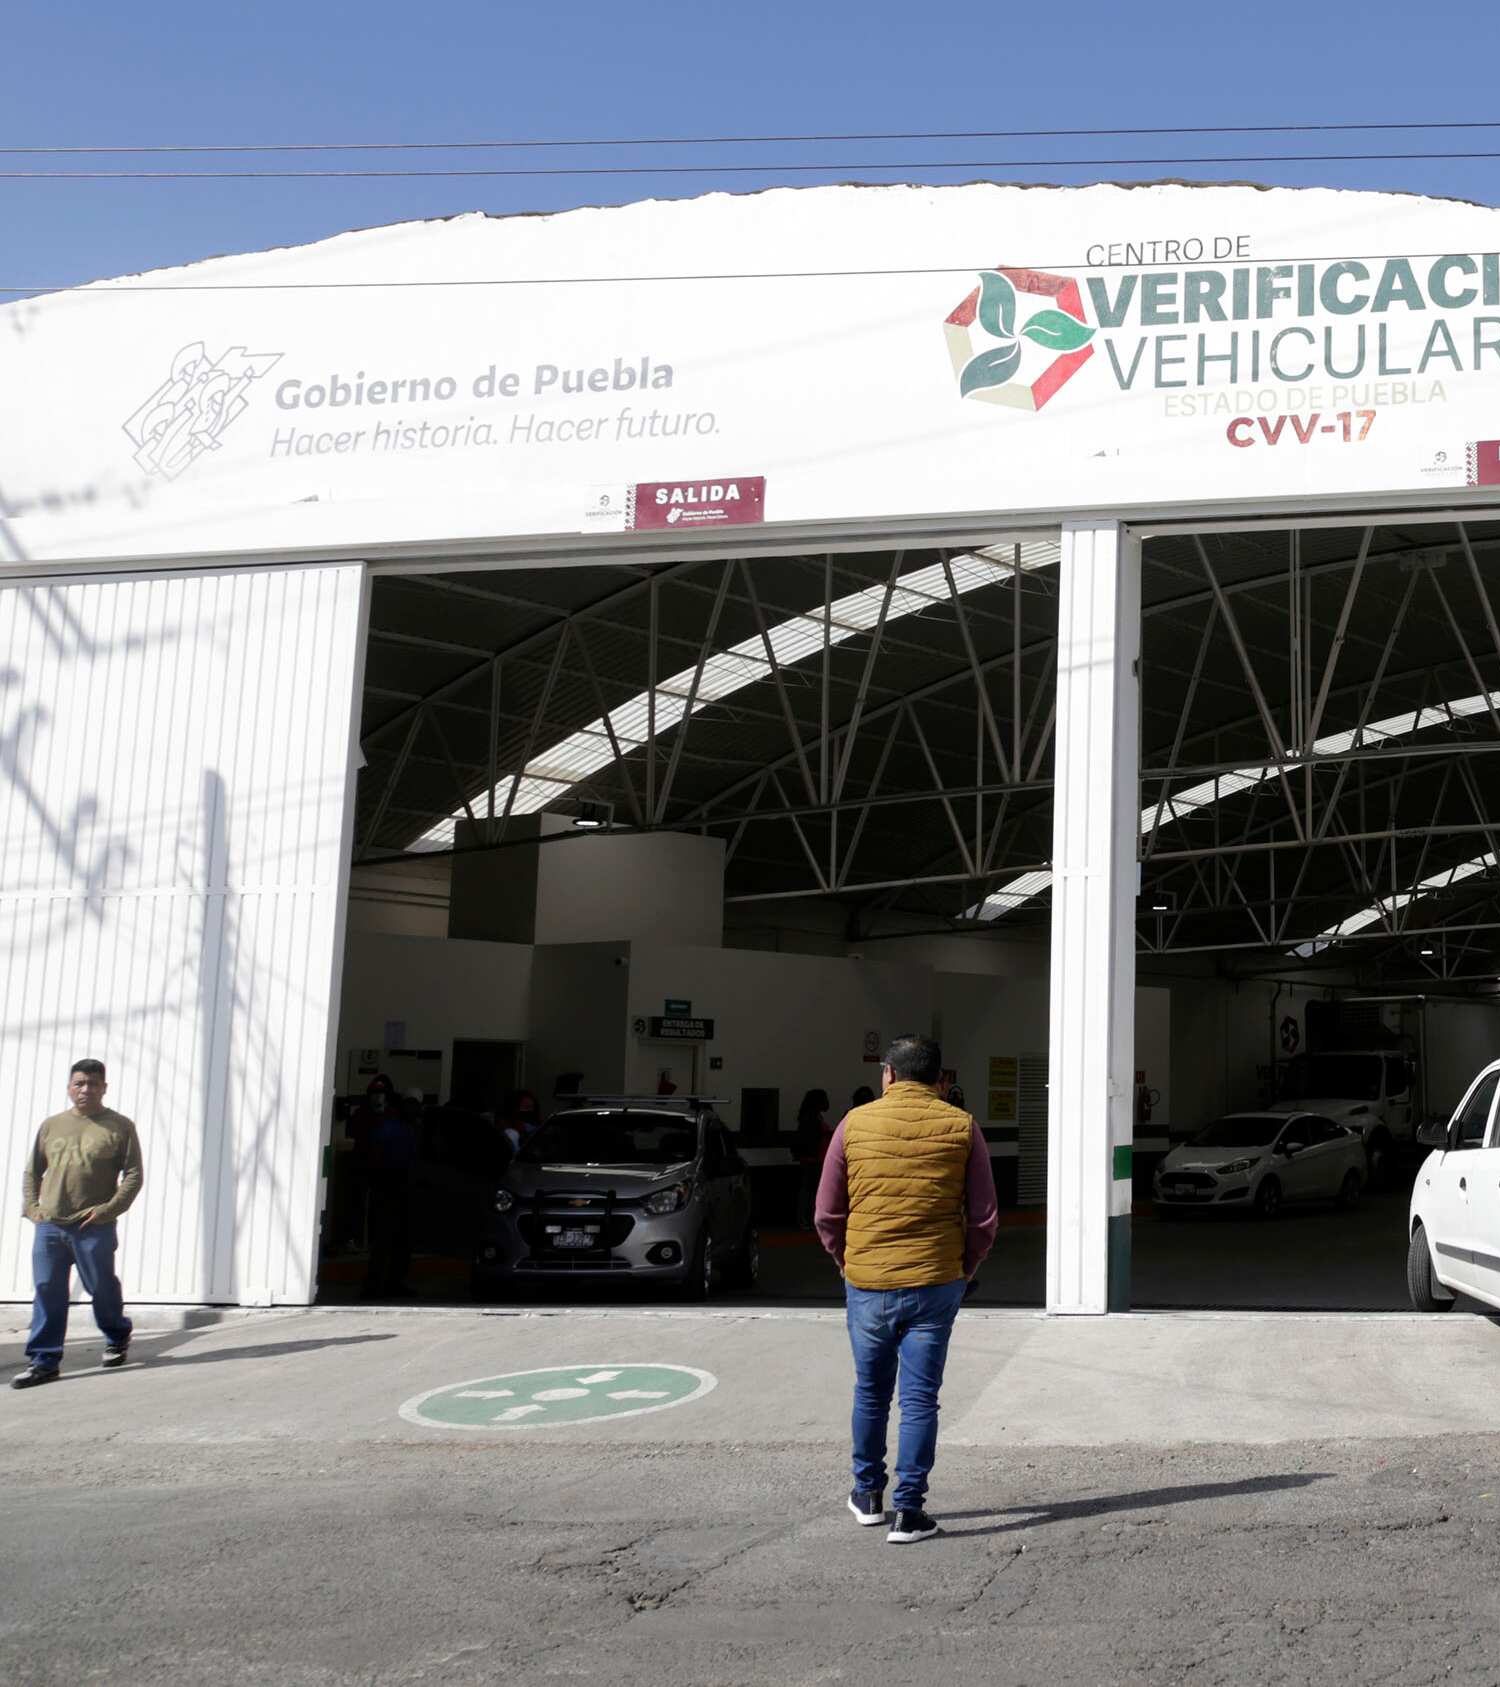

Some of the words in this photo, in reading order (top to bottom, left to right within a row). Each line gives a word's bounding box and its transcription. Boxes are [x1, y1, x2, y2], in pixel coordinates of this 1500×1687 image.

[1086, 239, 1203, 267] CENTRO
[1214, 236, 1251, 259] DE
[274, 371, 457, 410] Gobierno
[473, 365, 520, 399] de
[534, 357, 675, 396] Puebla
[1164, 387, 1281, 417] ESTADO
[1286, 386, 1323, 412] DE
[1331, 381, 1448, 408] PUEBLA
[270, 426, 366, 457] Hacer
[372, 416, 496, 450] historia.
[510, 414, 609, 443] Hacer
[615, 406, 721, 441] futuro.
[1226, 410, 1377, 448] CVV-17
[655, 484, 741, 505] SALIDA
